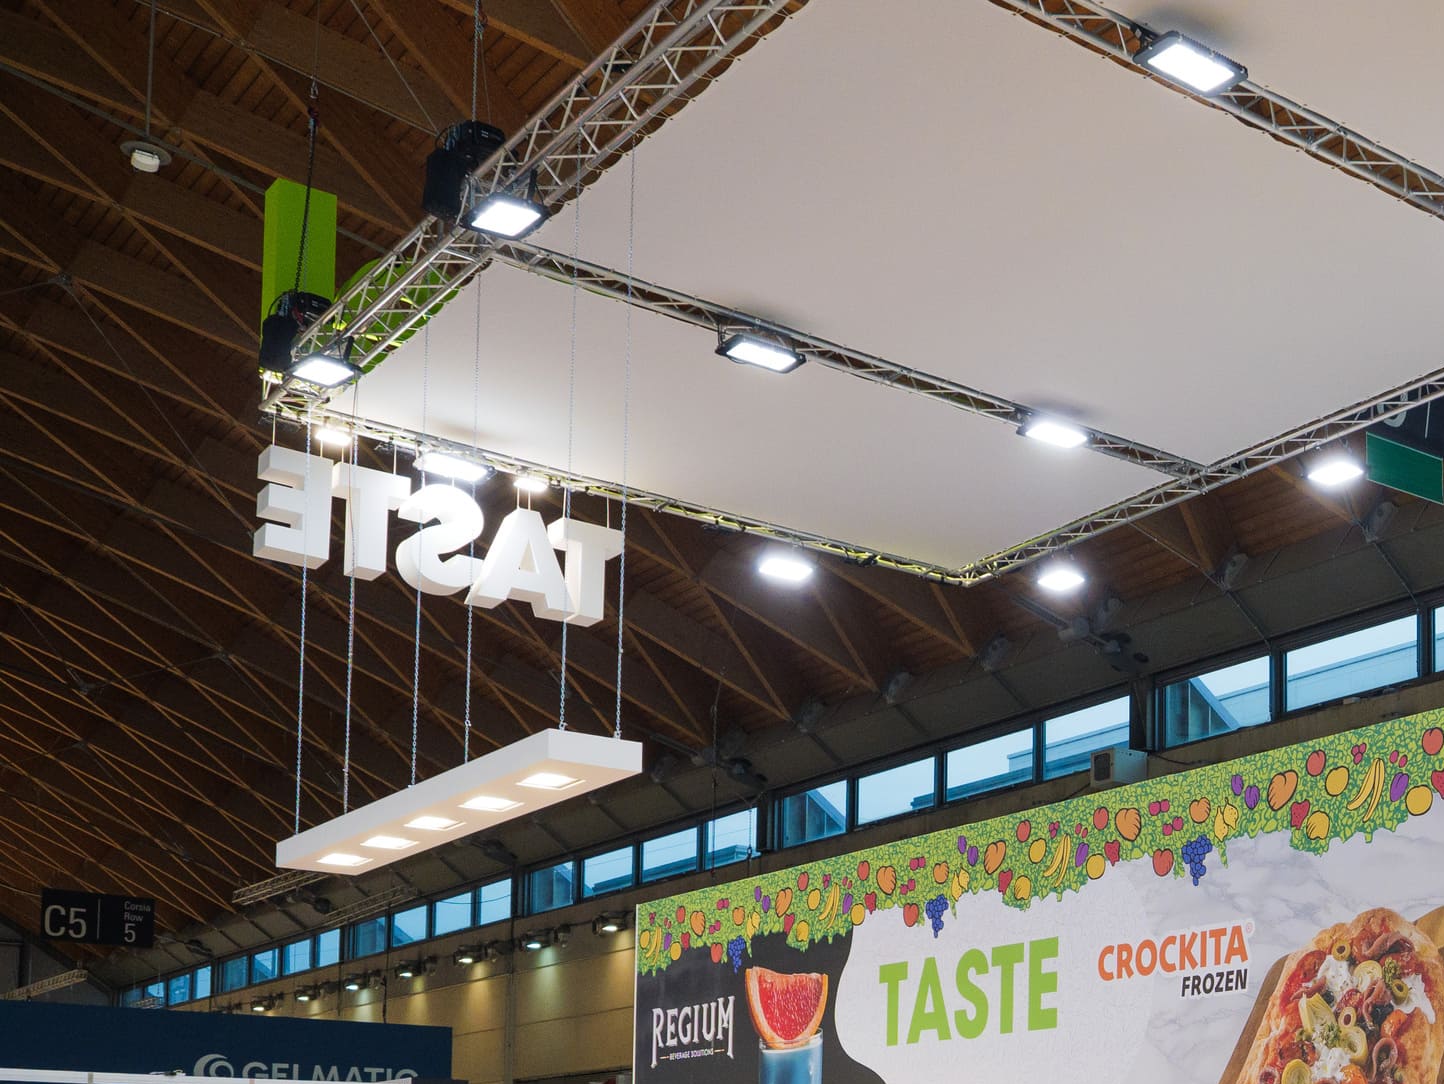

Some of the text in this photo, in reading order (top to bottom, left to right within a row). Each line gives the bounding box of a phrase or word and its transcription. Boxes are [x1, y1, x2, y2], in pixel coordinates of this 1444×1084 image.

[44, 904, 87, 939] C5
[124, 901, 151, 913] Corsia
[124, 911, 144, 923] Row
[124, 923, 136, 943] 5
[878, 935, 1060, 1047] TASTE
[1180, 968, 1249, 998] FROZEN
[650, 995, 736, 1069] REGIUM
